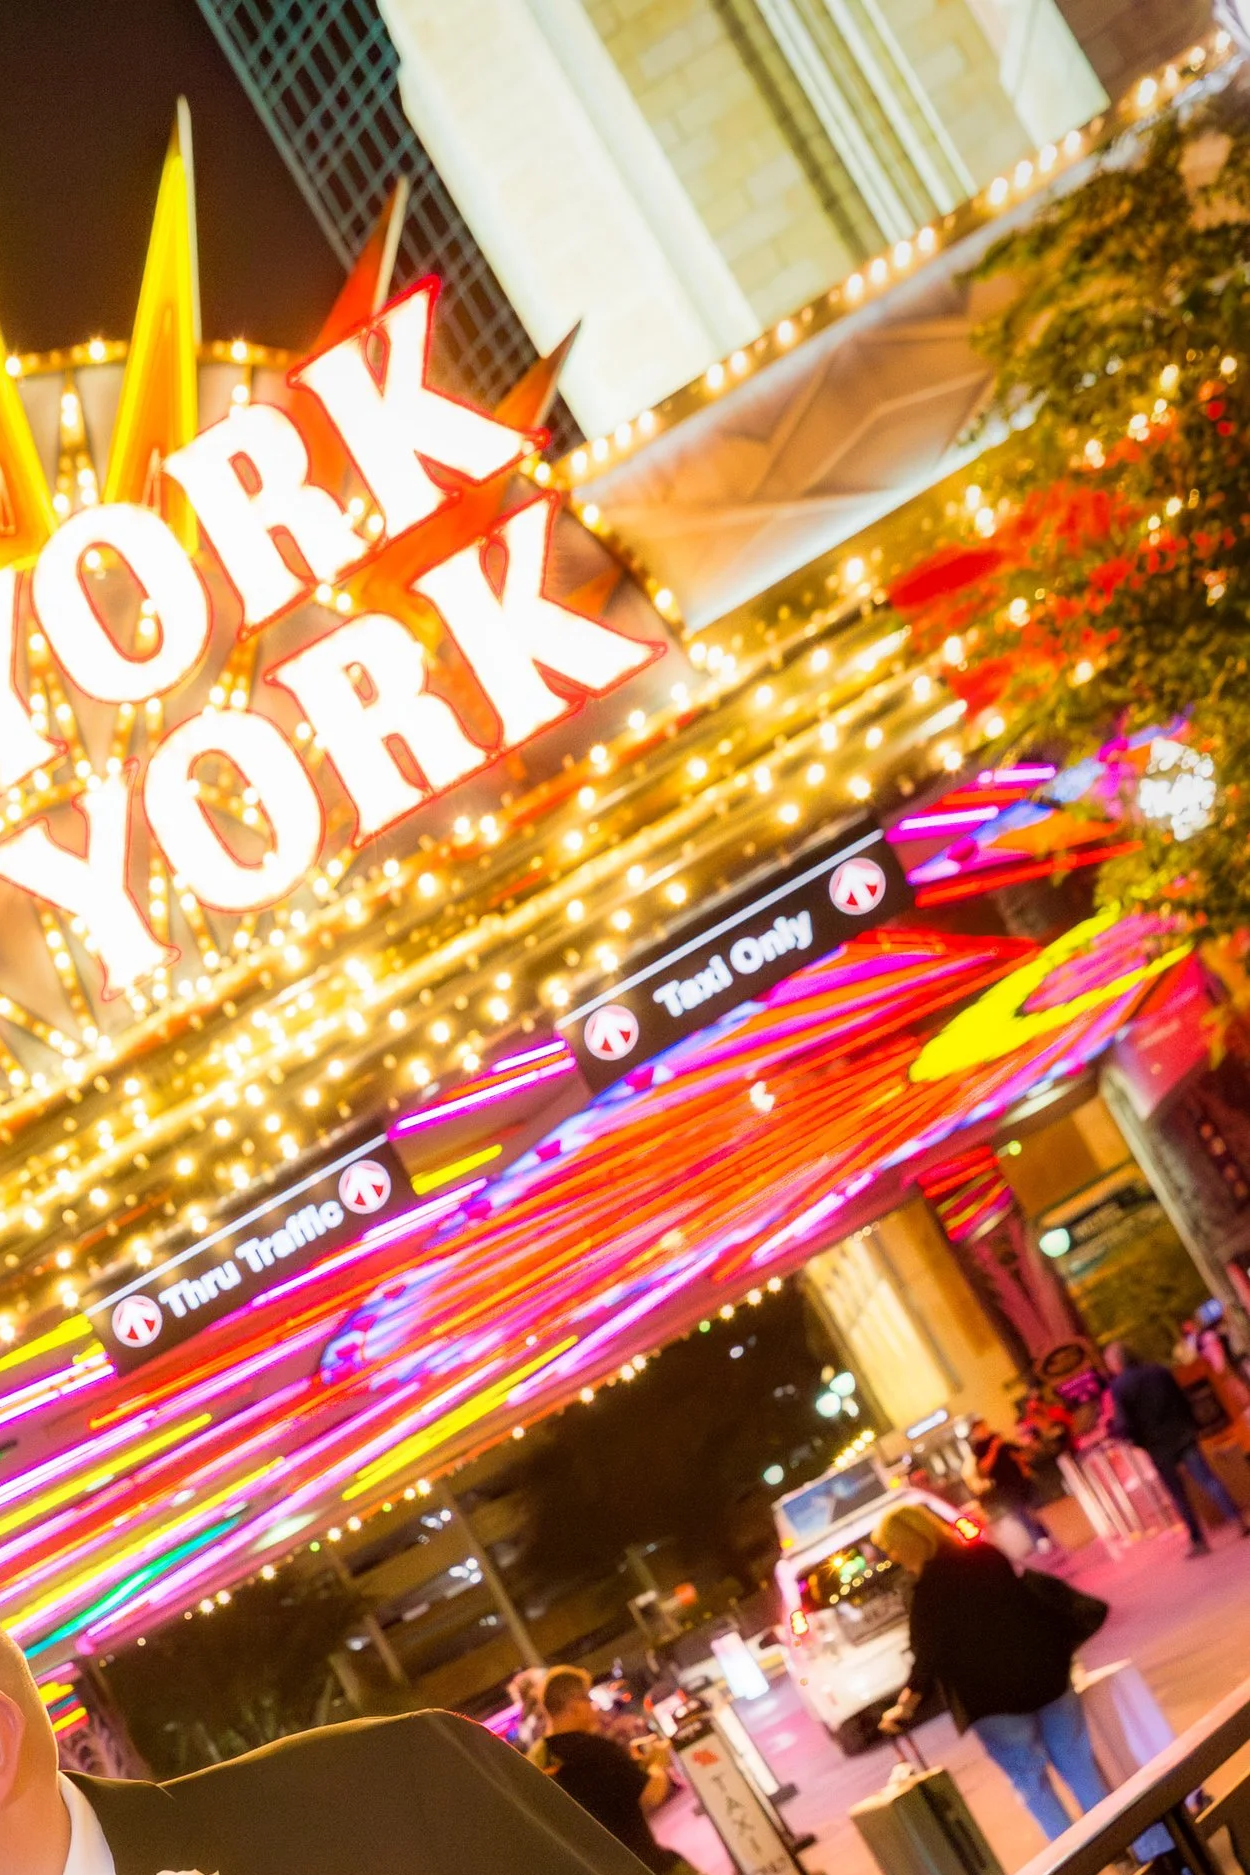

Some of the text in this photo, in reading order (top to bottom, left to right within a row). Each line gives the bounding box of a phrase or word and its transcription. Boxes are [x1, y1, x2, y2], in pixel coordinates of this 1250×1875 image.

[653, 911, 813, 1018] Taxi Only
[159, 1200, 344, 1317] Thru Traffic
[710, 1773, 764, 1856] TAXI
